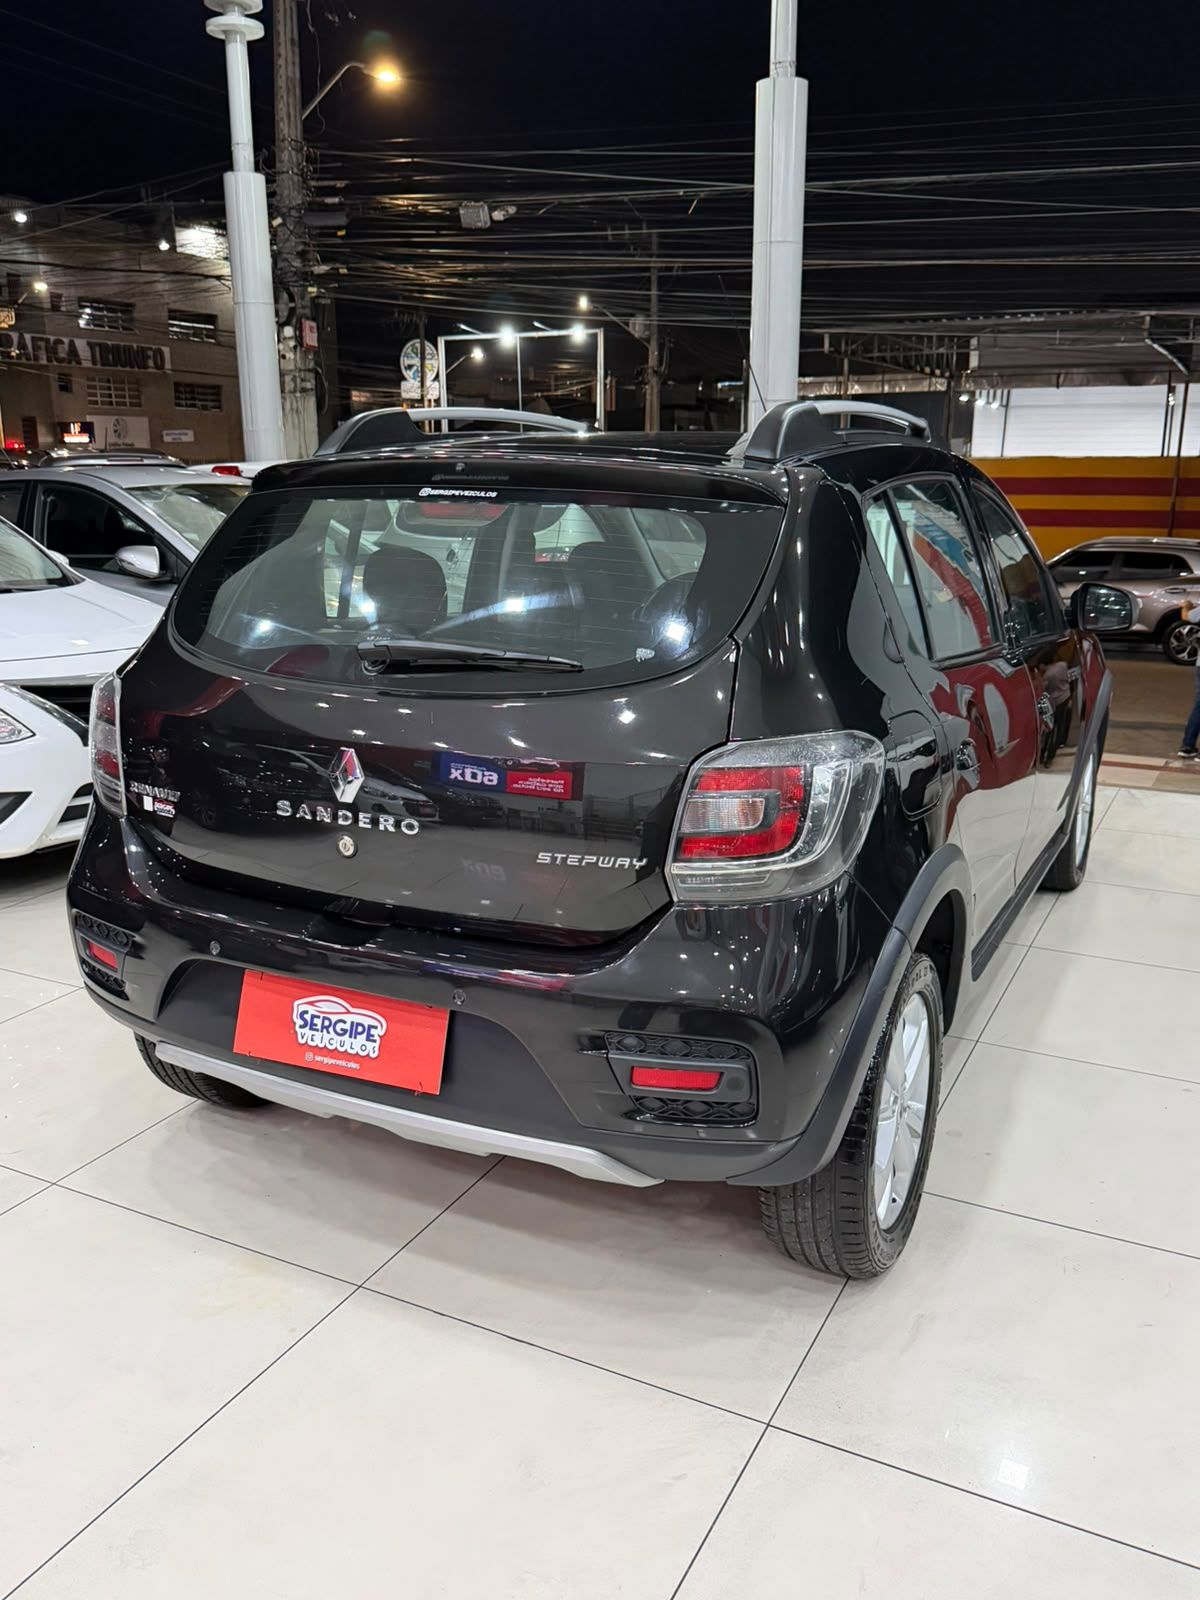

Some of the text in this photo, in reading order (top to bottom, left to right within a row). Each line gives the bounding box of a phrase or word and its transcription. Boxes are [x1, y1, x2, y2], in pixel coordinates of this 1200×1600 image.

[87, 340, 165, 370] TRIUNFO
[129, 780, 181, 803] RENAULT
[276, 800, 420, 836] SANDERO
[536, 852, 648, 870] STEPWAY
[299, 1009, 378, 1043] SERGIPE
[314, 1054, 360, 1069] sergipeveiculos
